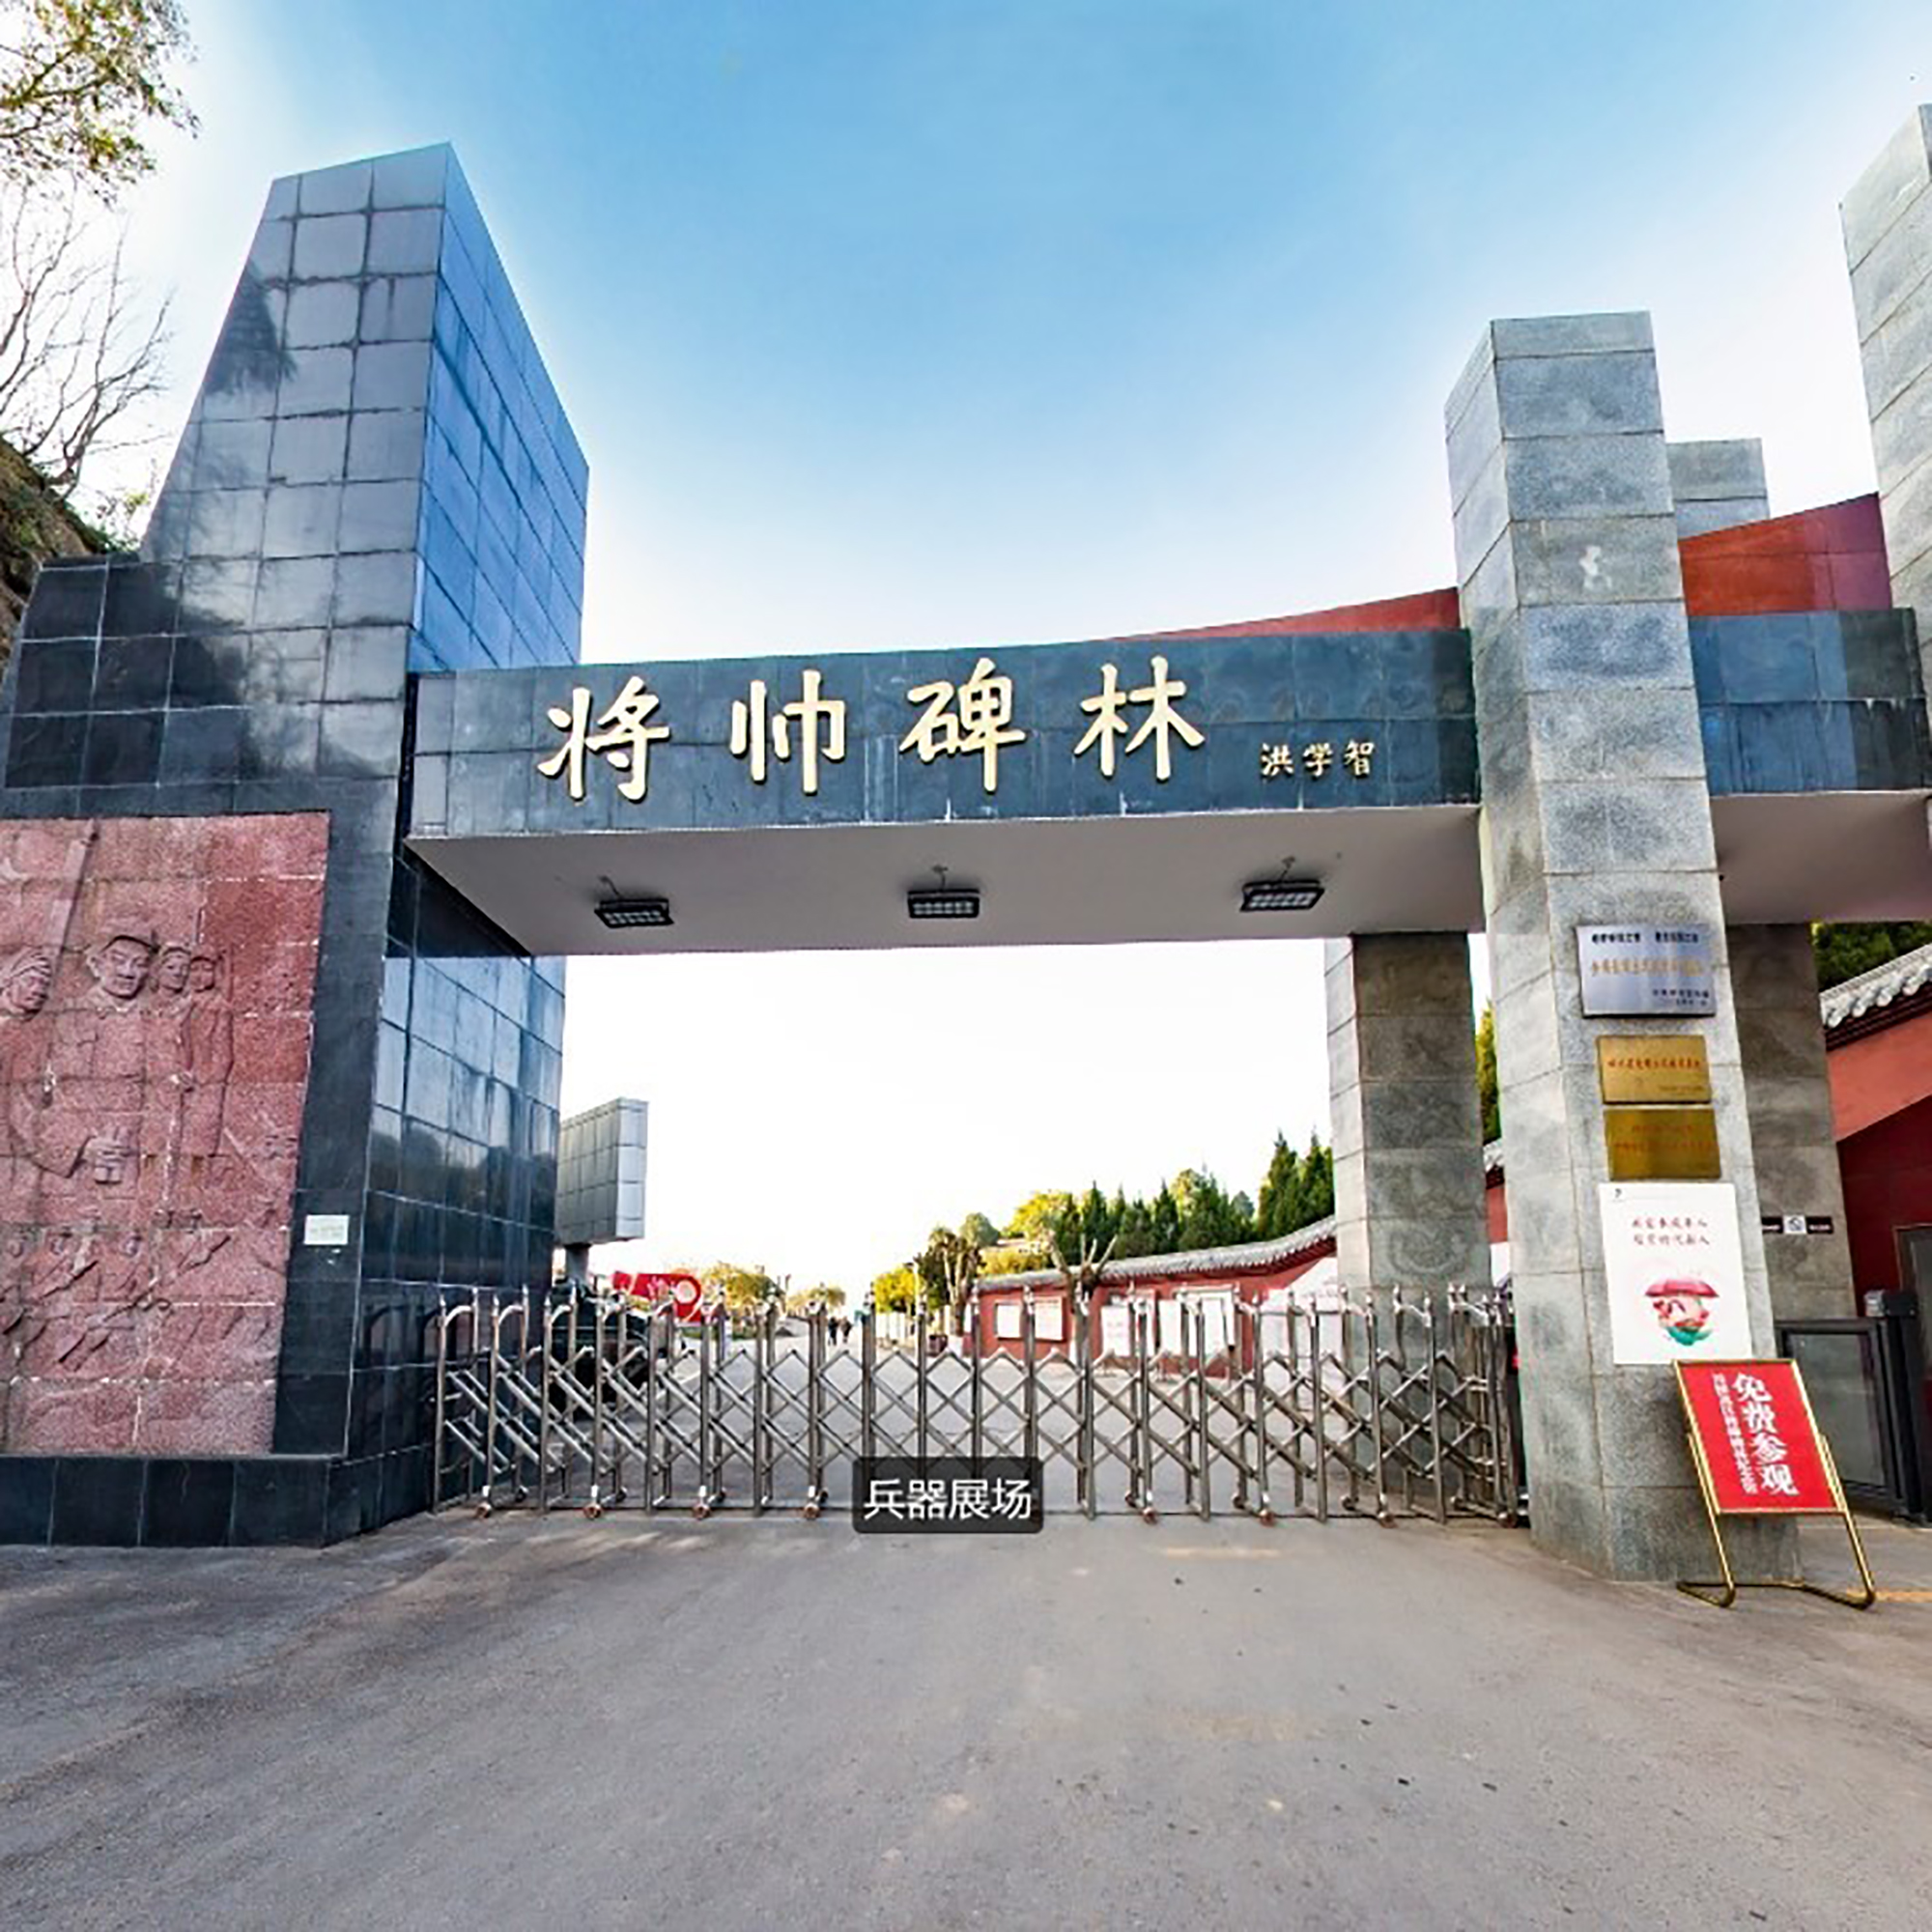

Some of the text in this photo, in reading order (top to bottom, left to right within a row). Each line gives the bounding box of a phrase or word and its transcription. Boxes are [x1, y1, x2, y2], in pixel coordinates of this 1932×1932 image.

[537, 655, 1206, 802] 将帅碑林
[1260, 739, 1376, 777] 洪学智
[1731, 1371, 1801, 1496] 免费参观
